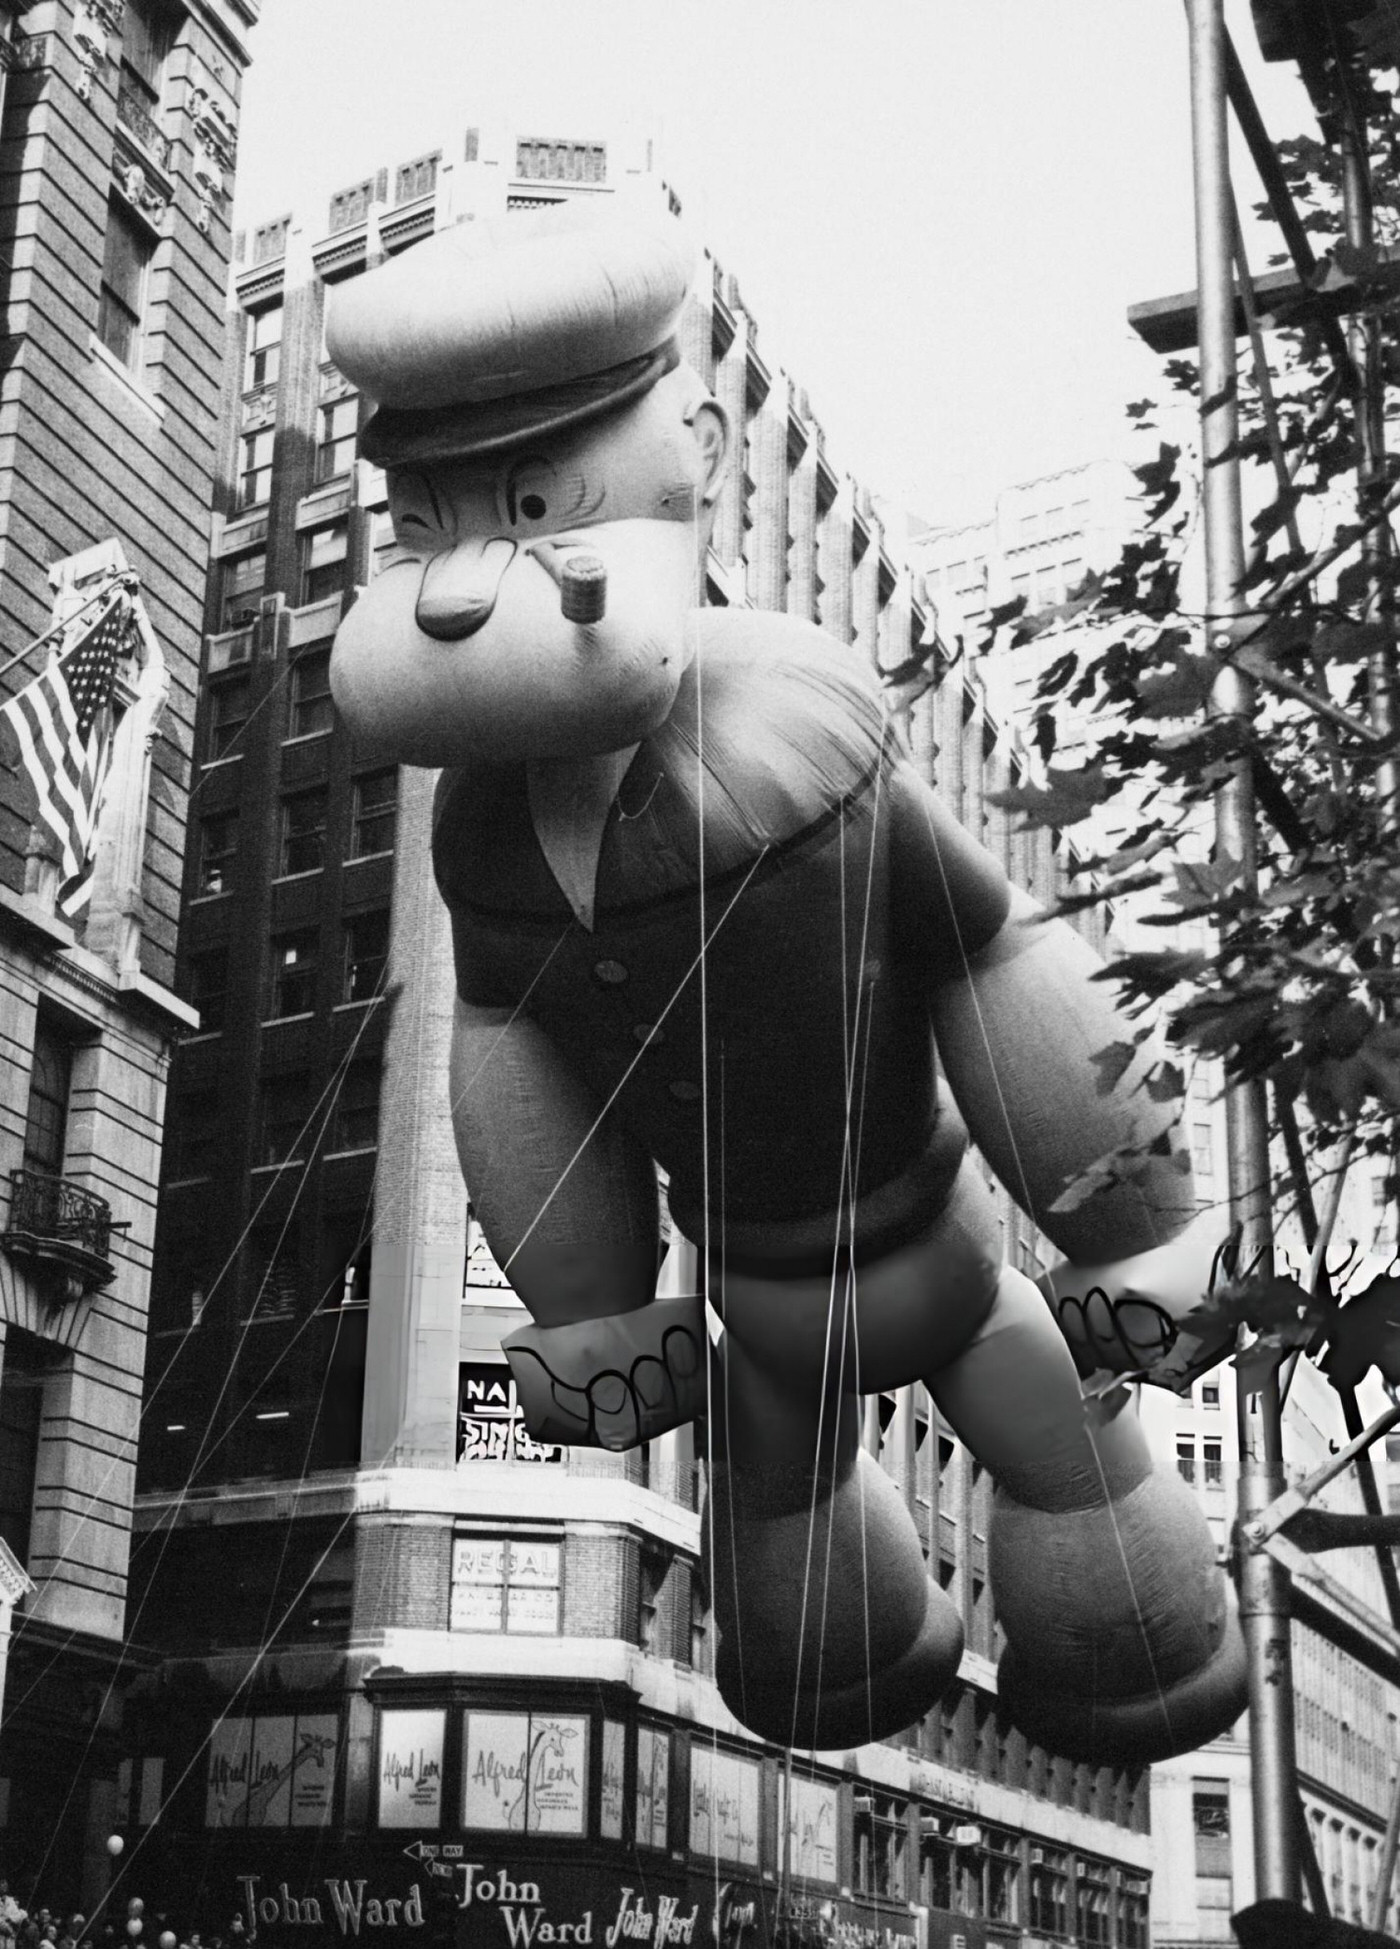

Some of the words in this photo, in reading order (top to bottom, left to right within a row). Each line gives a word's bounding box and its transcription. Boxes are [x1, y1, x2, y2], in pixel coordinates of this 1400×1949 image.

[383, 1751, 414, 1792] Alfred
[415, 1748, 441, 1787] Leon
[472, 1750, 527, 1798] Alfred
[534, 1749, 579, 1791] Leon
[445, 1847, 462, 1856] WAY
[455, 1863, 542, 1908] John
[237, 1876, 323, 1941] John
[324, 1879, 425, 1936] Ward
[499, 1906, 593, 1949] Ward
[605, 1887, 653, 1948] John
[653, 1894, 699, 1949] Ward
